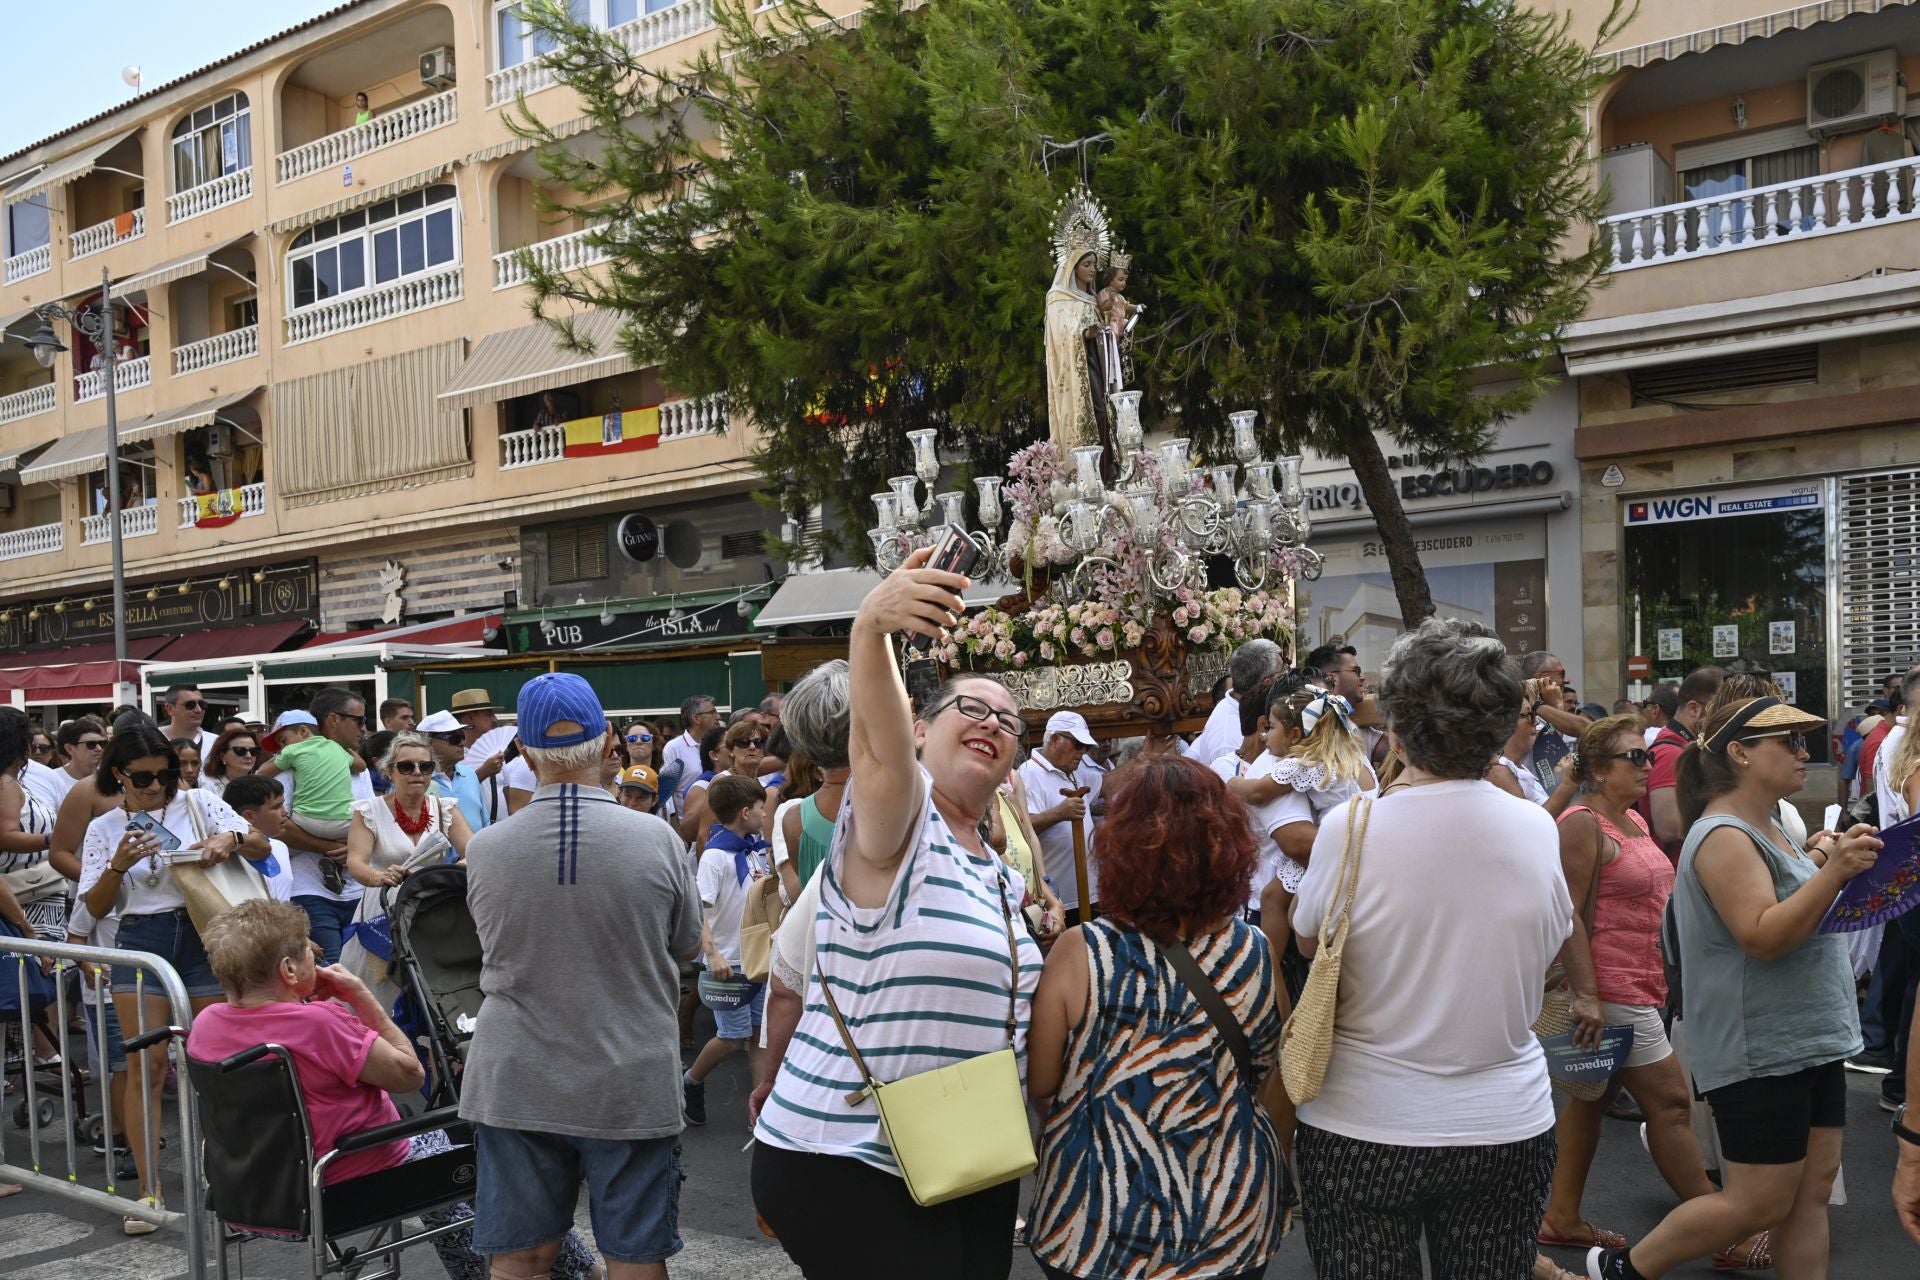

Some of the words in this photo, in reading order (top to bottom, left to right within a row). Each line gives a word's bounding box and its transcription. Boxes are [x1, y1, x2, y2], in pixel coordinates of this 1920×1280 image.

[1401, 460, 1554, 499] ESCUDERO
[1791, 484, 1818, 494] wgn.pl
[1653, 496, 1712, 520] WGN
[1721, 502, 1742, 512] REAL
[1743, 500, 1773, 510] ESTATE
[545, 625, 582, 645] PUB
[645, 615, 660, 627] the
